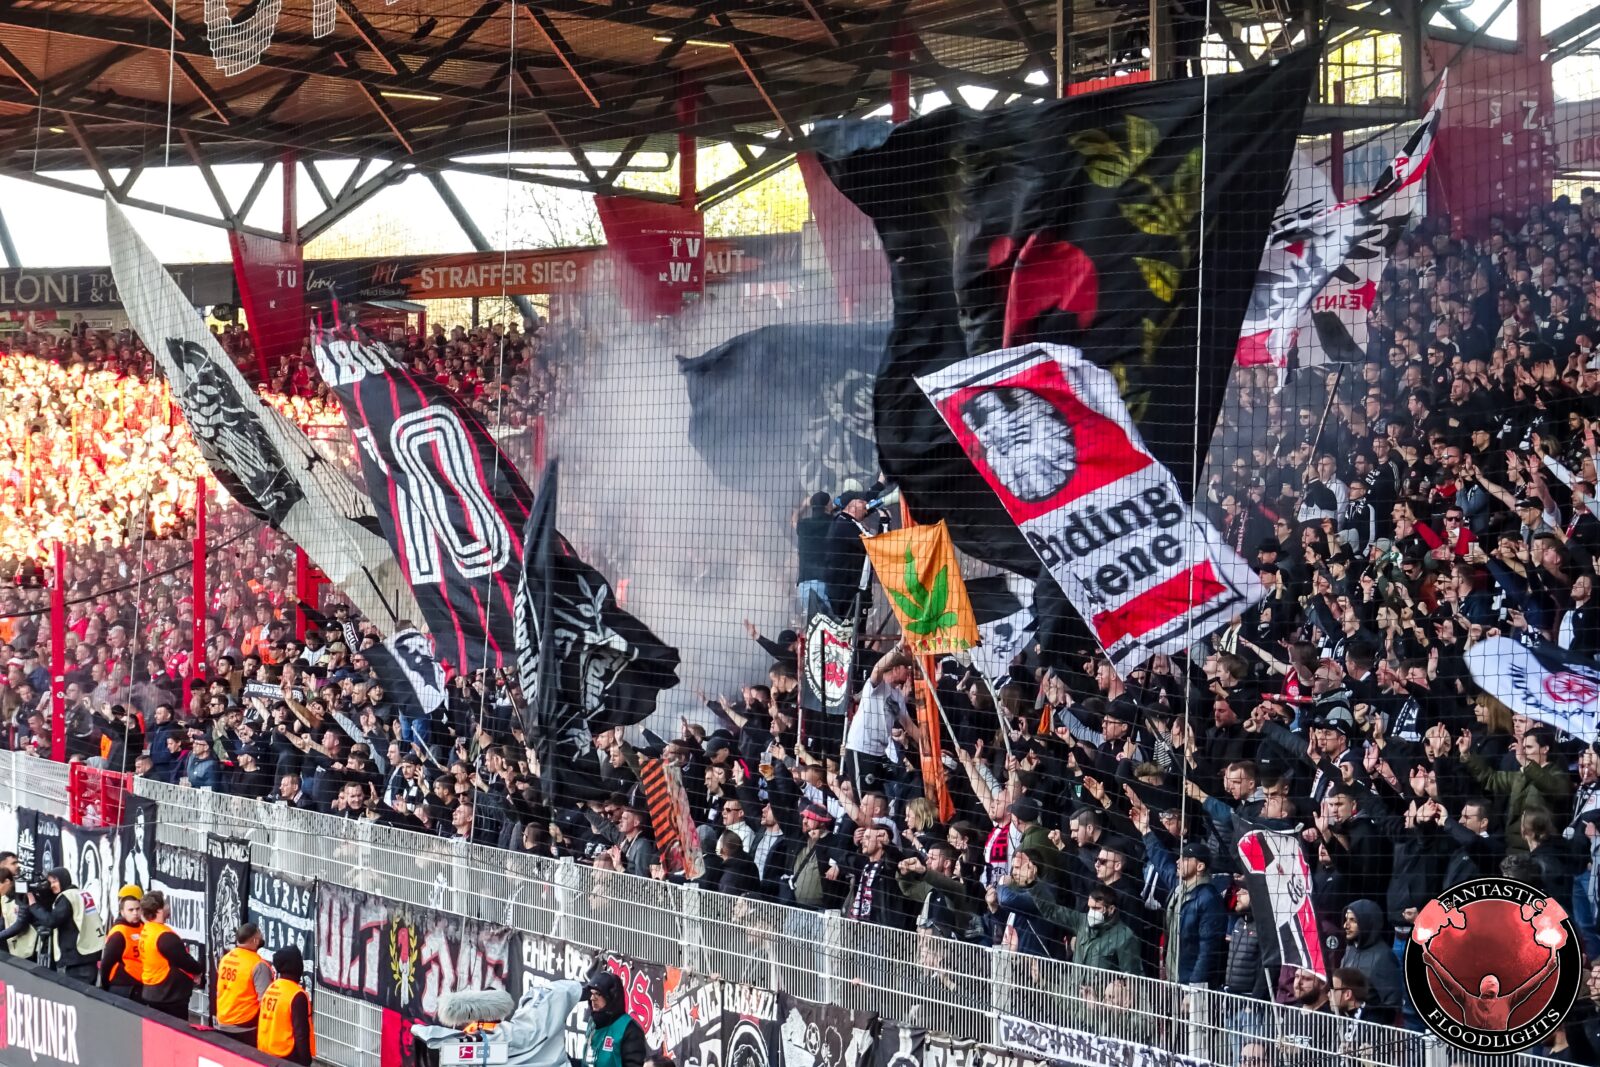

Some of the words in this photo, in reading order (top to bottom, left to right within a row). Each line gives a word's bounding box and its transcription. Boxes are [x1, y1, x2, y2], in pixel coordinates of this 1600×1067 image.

[420, 262, 526, 290] STRAFFER
[531, 260, 577, 285] SIEG
[254, 872, 310, 917] ULTRAS
[221, 966, 237, 982] 286
[6, 984, 80, 1065] BERLINER
